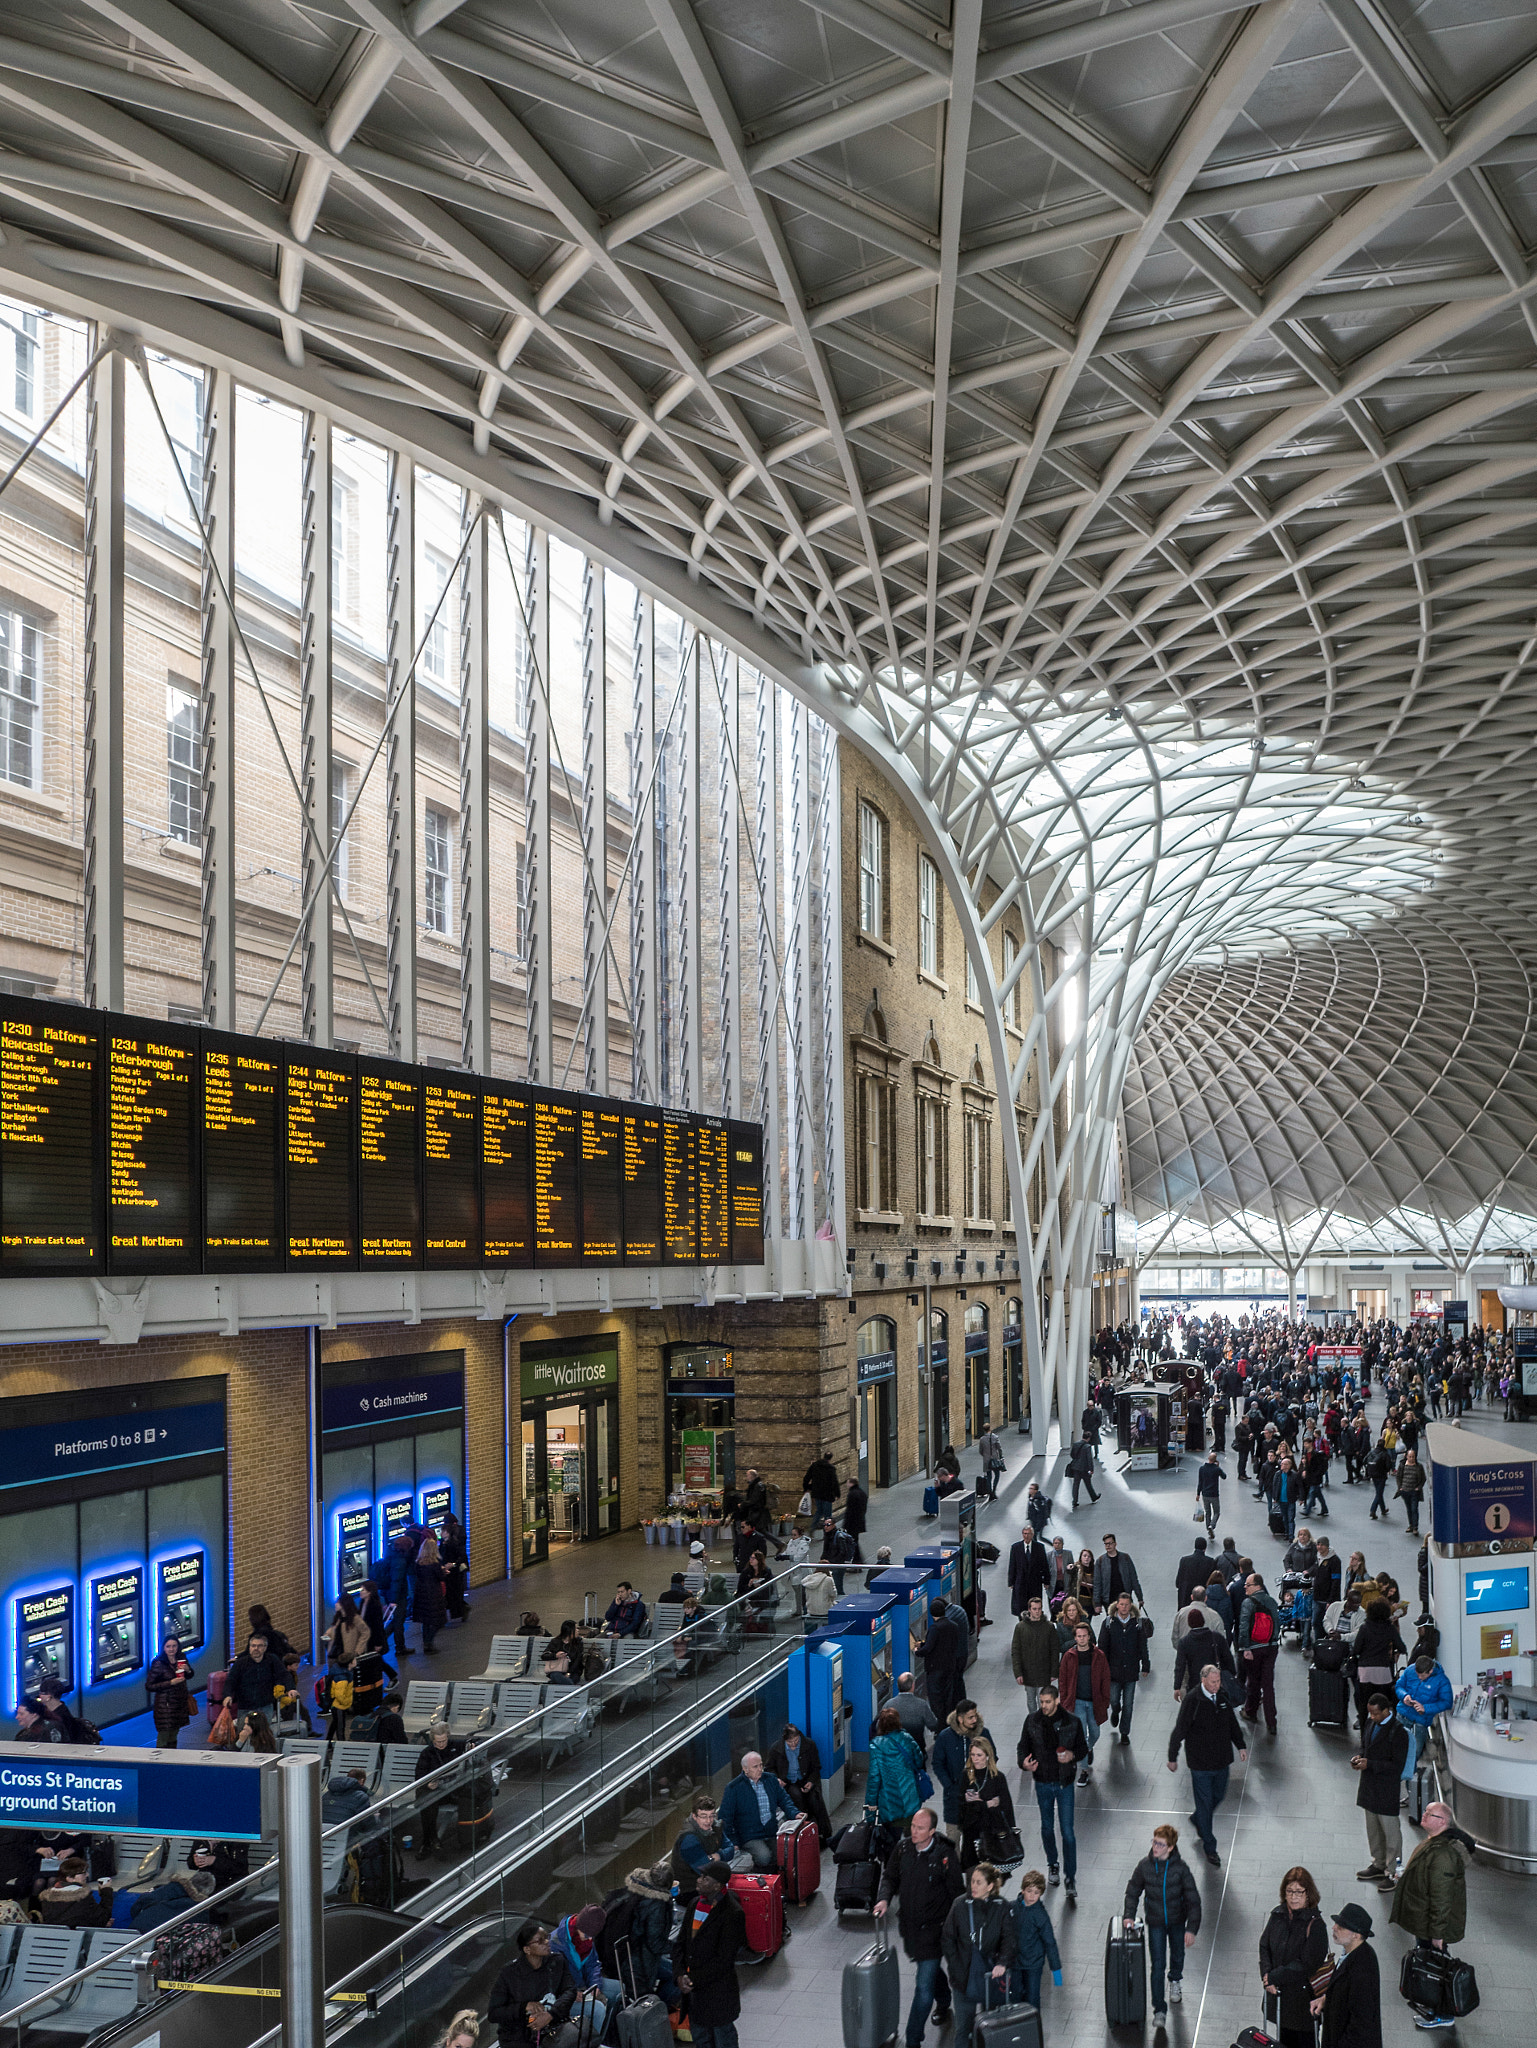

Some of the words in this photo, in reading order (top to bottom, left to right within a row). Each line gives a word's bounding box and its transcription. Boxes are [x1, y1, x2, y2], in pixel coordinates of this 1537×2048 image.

[3, 1021, 32, 1036] 12:30
[44, 1028, 86, 1044] Platform
[1, 1036, 53, 1054] Newcastle
[112, 1038, 137, 1052] 12:34
[147, 1044, 184, 1058] Platform
[111, 1052, 173, 1071] Peterborough
[207, 1052, 229, 1065] 12:35
[237, 1057, 270, 1071] Platform
[206, 1065, 230, 1078] Leeds
[289, 1065, 308, 1076] 12:44
[316, 1069, 345, 1082] Platform
[2, 1236, 22, 1246] Virgin
[112, 1236, 138, 1246] Great
[142, 1236, 183, 1246] Northern
[290, 1238, 310, 1247] Great
[312, 1238, 344, 1247] Northern
[535, 1364, 552, 1379] little
[552, 1361, 605, 1386] Waitrose
[373, 1396, 392, 1408] Cash
[393, 1392, 427, 1405] machines
[55, 1440, 108, 1456] Platforms
[111, 1436, 117, 1447] 0
[120, 1436, 131, 1446] to
[134, 1432, 140, 1444] 8
[1469, 1471, 1496, 1483] King's
[1498, 1470, 1524, 1480] Cross
[437, 1492, 449, 1501] Cash
[398, 1503, 411, 1512] Cash
[343, 1518, 355, 1526] Free
[356, 1513, 369, 1523] Cash
[163, 1565, 180, 1576] Free
[181, 1559, 199, 1572] Cash
[165, 1569, 197, 1582] withdrawals
[98, 1582, 116, 1594] Free
[117, 1576, 137, 1589] Cash
[100, 1586, 135, 1601] withdrawals
[24, 1602, 44, 1614] Free
[46, 1594, 68, 1608] Cash
[26, 1606, 65, 1622] withdrawals
[1, 1770, 42, 1786] Cross
[45, 1772, 62, 1787] St
[66, 1773, 122, 1790] Pancras
[61, 1796, 116, 1812] Station
